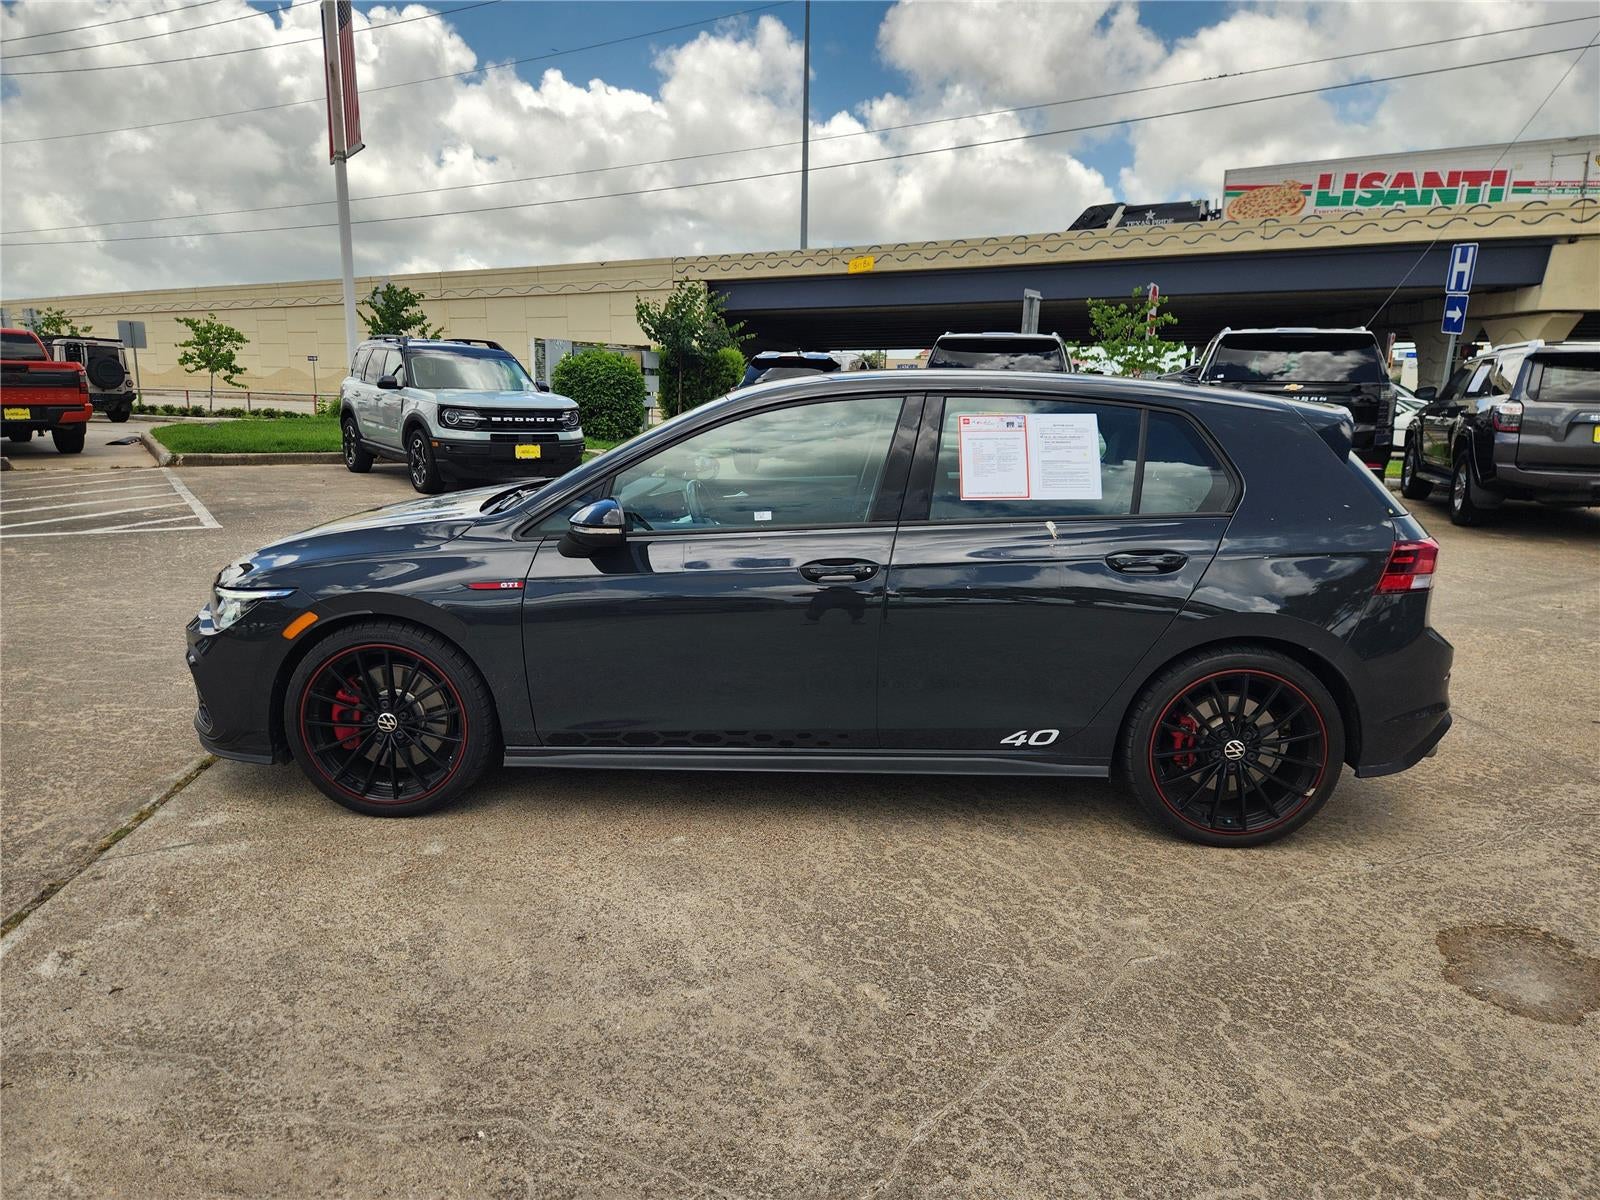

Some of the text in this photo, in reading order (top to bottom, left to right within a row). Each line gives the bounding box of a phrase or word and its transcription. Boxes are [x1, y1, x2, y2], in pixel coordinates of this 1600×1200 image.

[1314, 169, 1508, 207] LISANTI
[1449, 246, 1474, 290] H
[1000, 729, 1060, 747] 40
